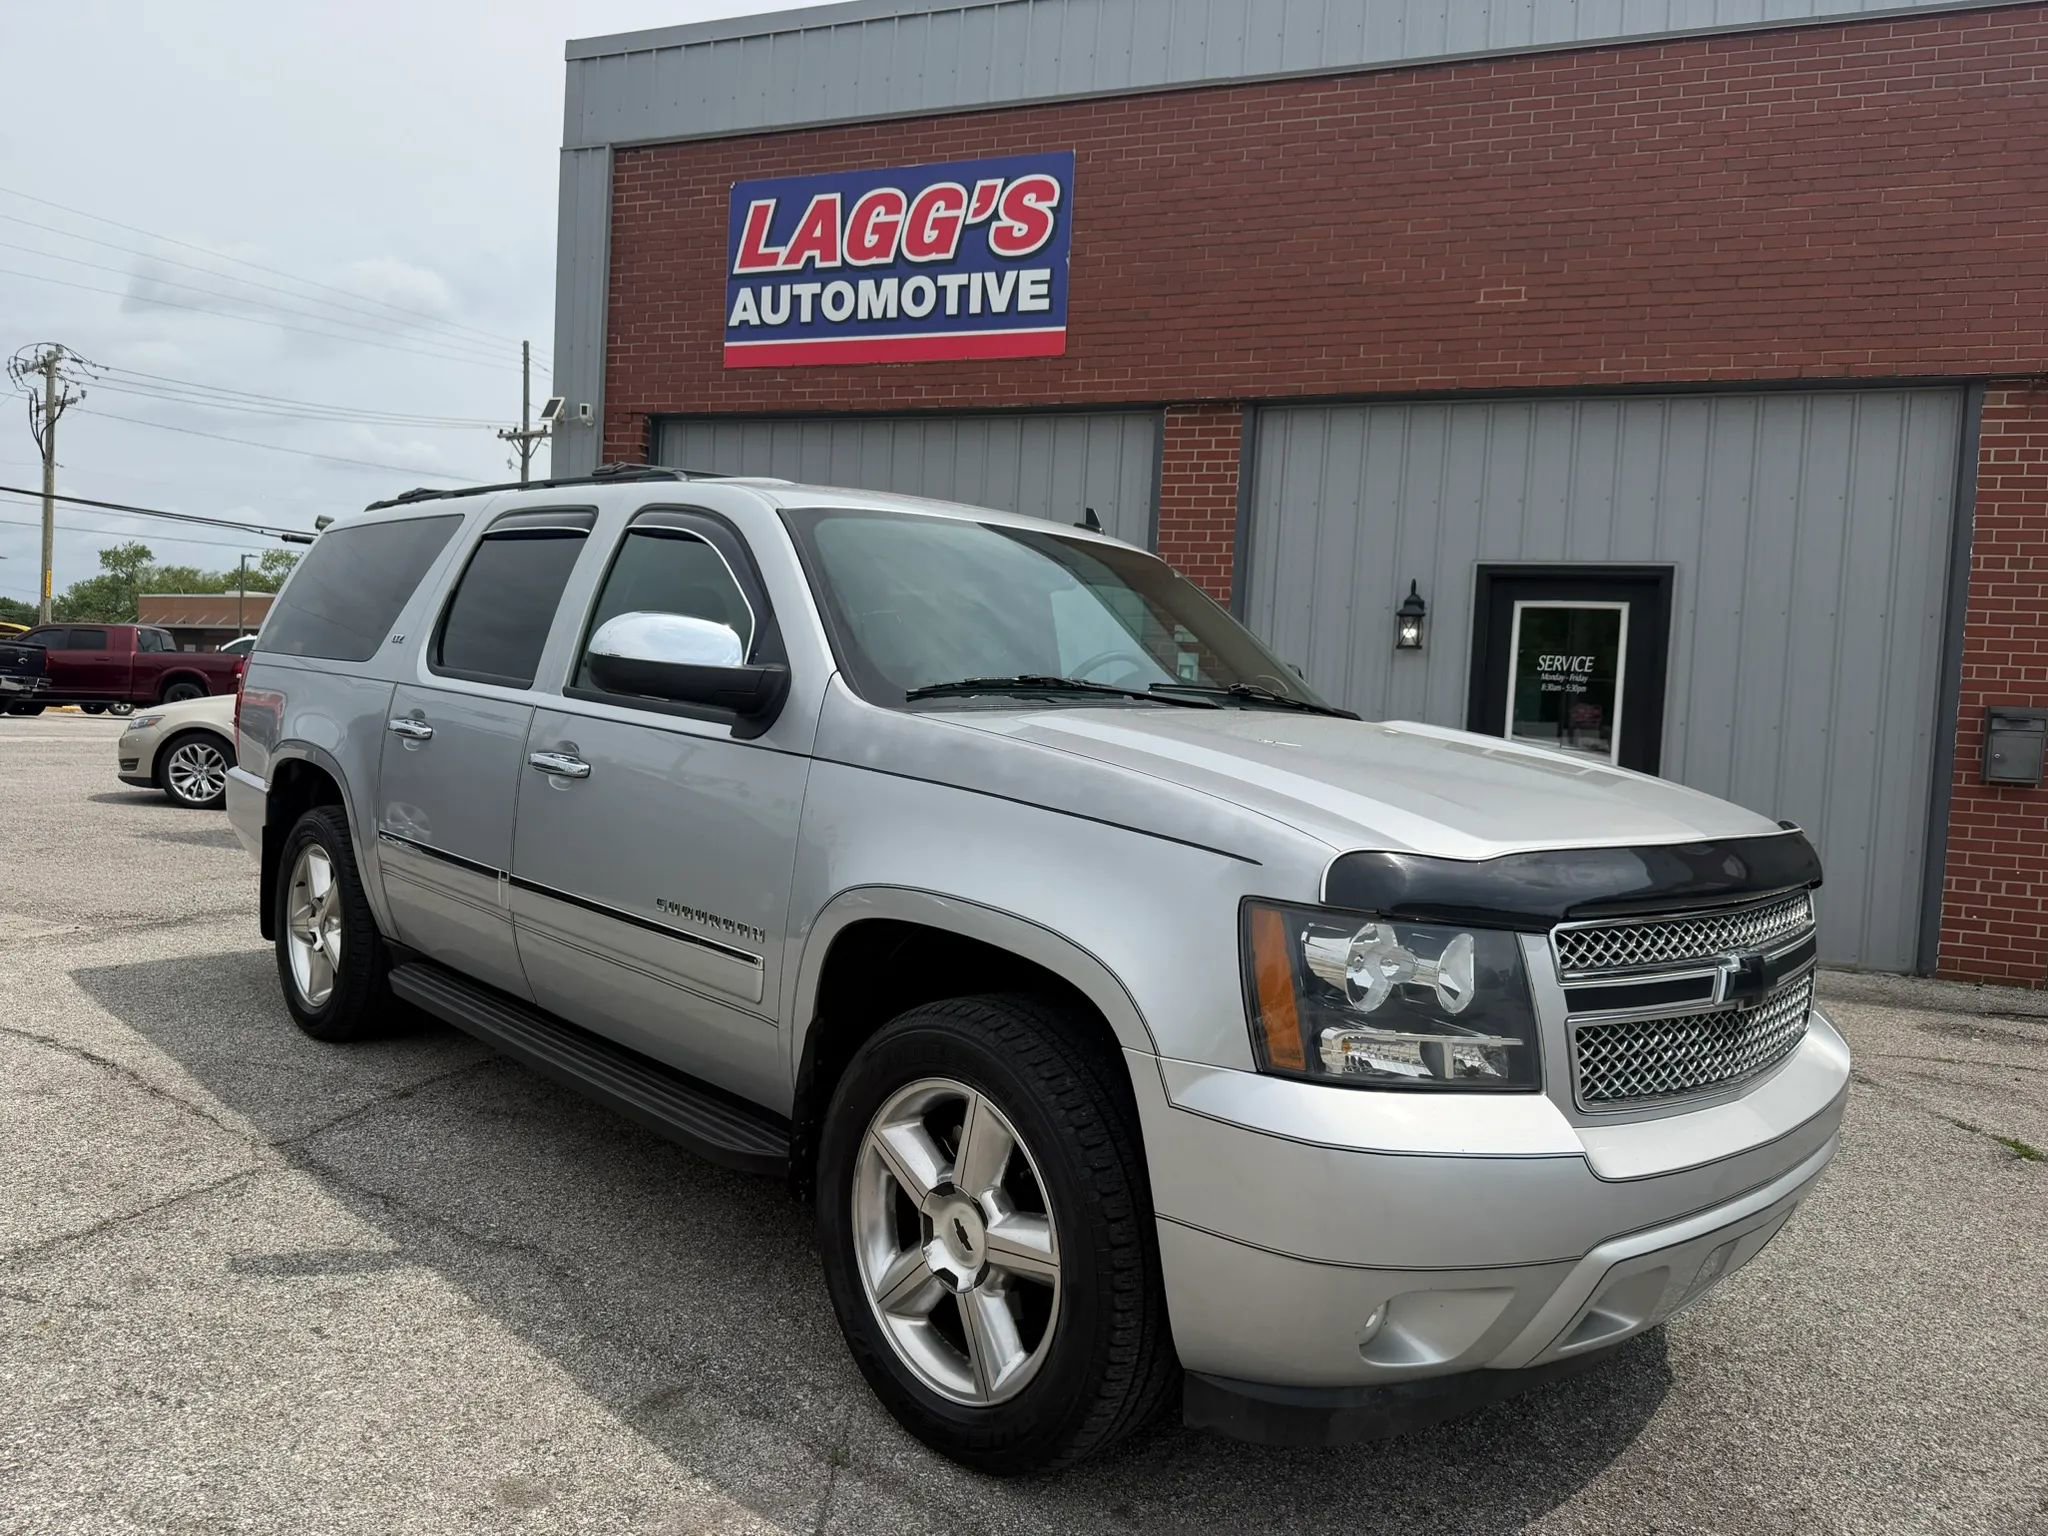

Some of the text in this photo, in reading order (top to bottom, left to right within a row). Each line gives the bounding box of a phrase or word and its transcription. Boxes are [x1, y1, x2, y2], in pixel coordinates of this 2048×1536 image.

[733, 174, 1061, 275] LAGG'S
[728, 268, 1051, 327] AUTOMOTIVE
[1536, 654, 1595, 672] SERVICE
[1541, 673, 1565, 682] Monday
[1569, 673, 1588, 683] Friday
